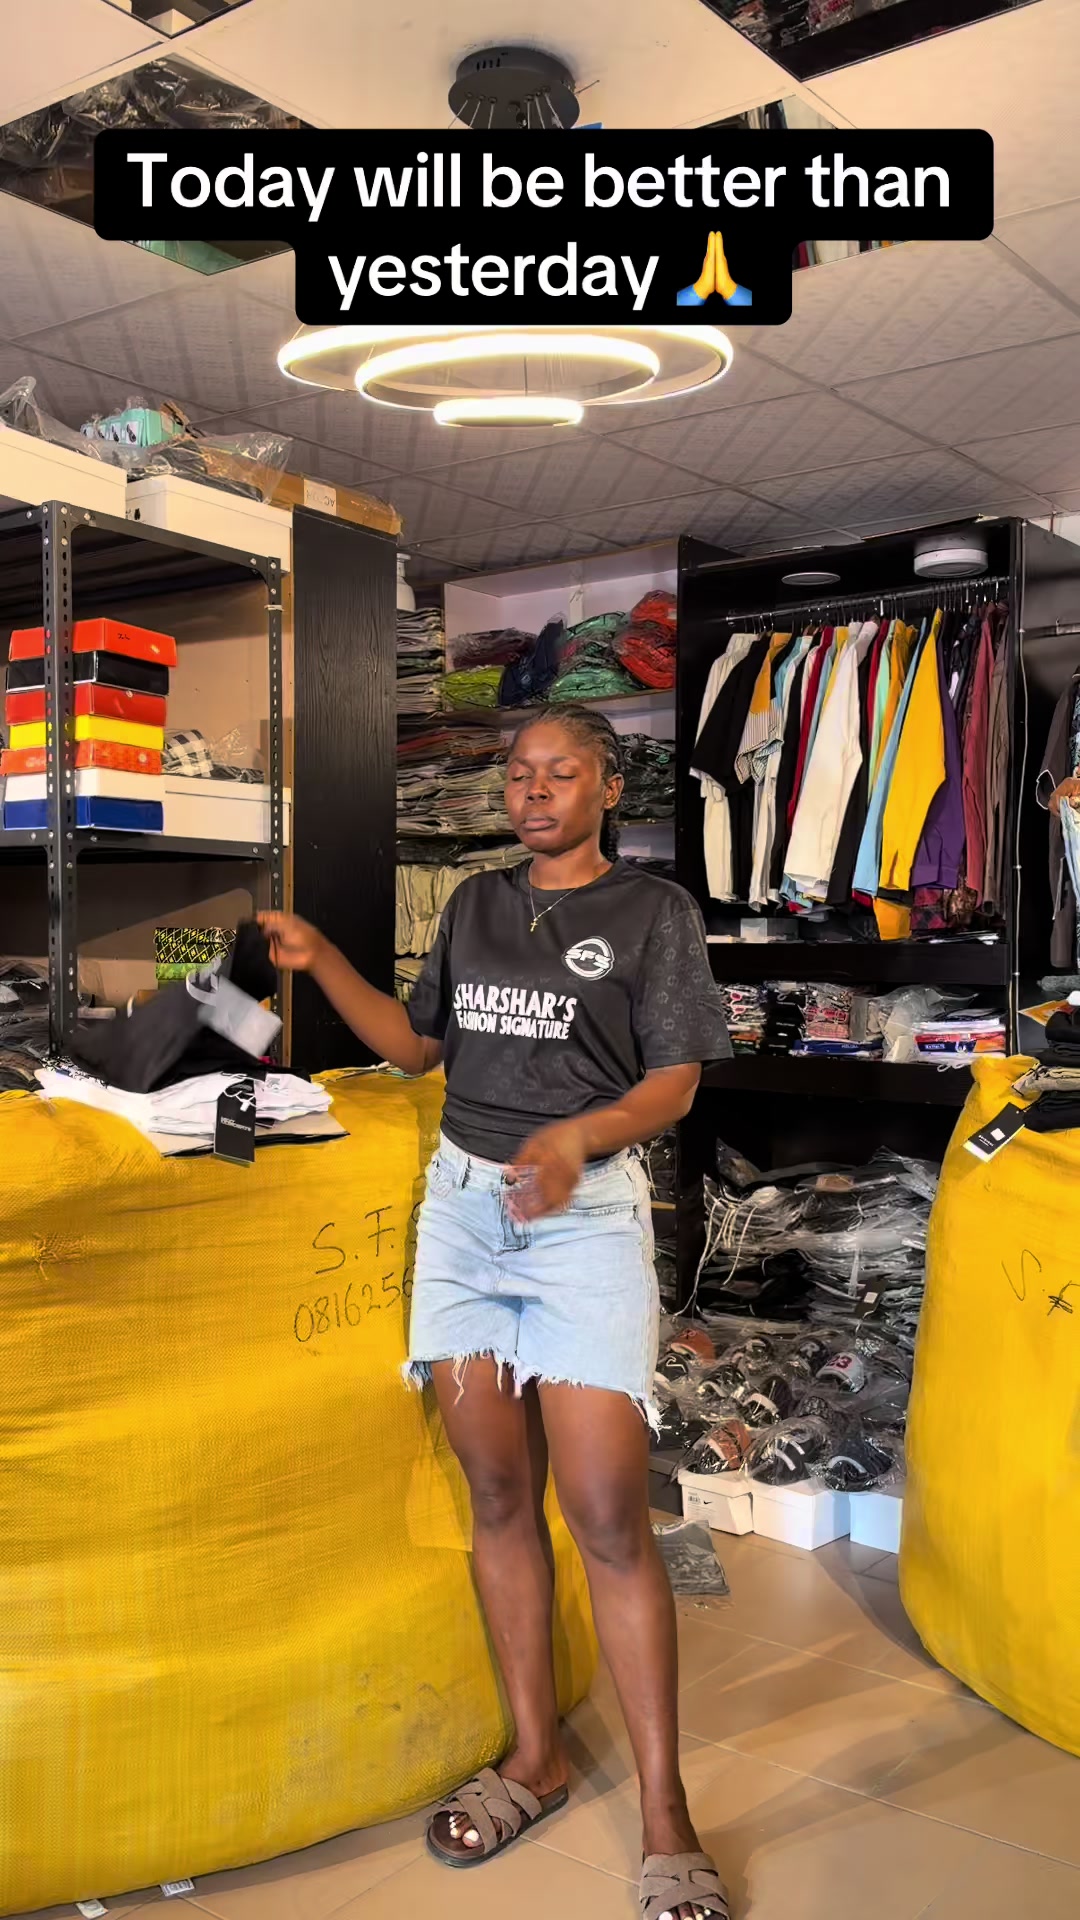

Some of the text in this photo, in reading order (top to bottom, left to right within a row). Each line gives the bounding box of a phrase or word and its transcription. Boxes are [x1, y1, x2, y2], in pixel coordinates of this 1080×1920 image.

[564, 948, 611, 970] SFS
[453, 983, 578, 1022] SHARSHAR'S
[499, 1015, 571, 1040] SIGNATURE
